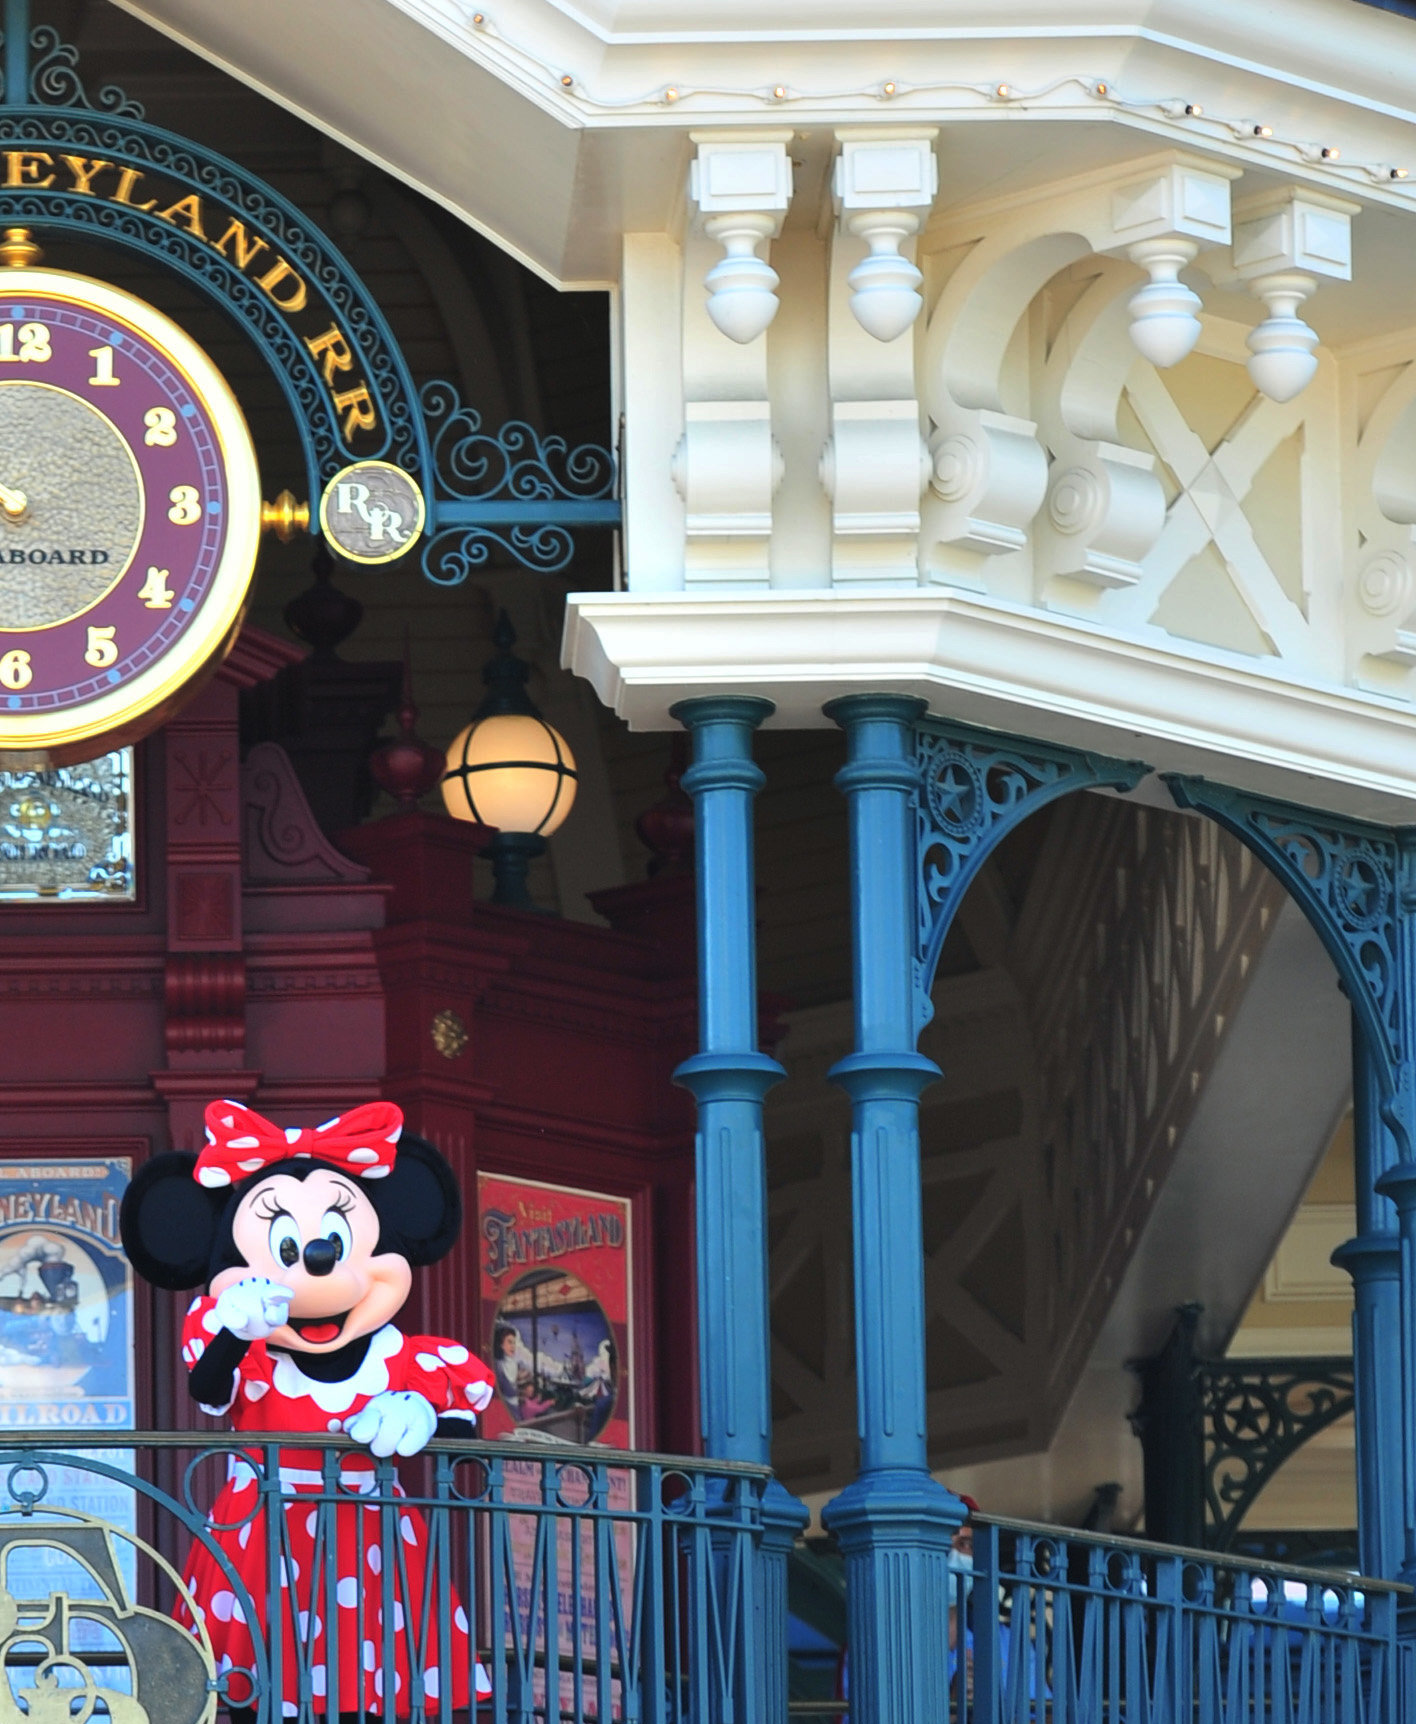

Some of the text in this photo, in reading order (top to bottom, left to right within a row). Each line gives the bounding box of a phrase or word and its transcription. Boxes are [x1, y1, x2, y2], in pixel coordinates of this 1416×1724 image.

[88, 346, 121, 386] 1
[302, 321, 377, 444] RR
[144, 407, 178, 447] 2
[168, 486, 202, 526] 3
[137, 566, 175, 609] 4
[84, 625, 119, 667] 5
